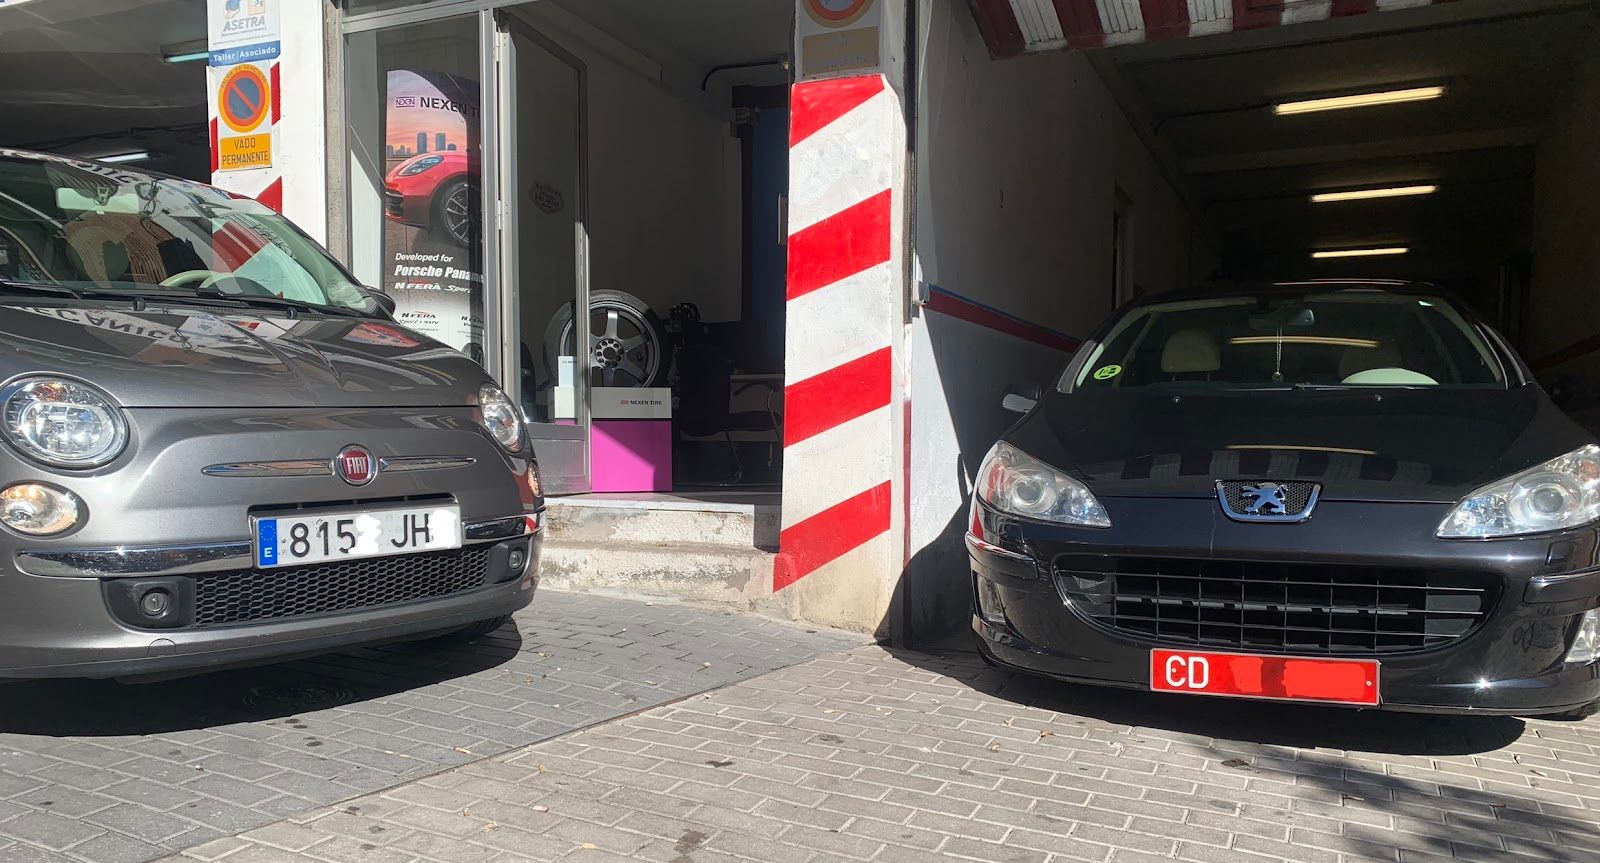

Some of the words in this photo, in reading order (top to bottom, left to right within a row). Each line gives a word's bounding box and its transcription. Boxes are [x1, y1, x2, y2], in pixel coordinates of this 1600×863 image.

[223, 15, 266, 31] ASETRA
[213, 53, 236, 62] Taller
[239, 46, 276, 58] Asociado
[420, 96, 467, 115] NEXEN
[233, 137, 256, 149] VADO
[222, 150, 269, 166] PERMANENTE
[395, 253, 440, 262] Developed
[440, 254, 454, 262] for
[394, 264, 443, 277] Porsche
[346, 456, 368, 475] FIAT
[289, 518, 357, 558] 815
[391, 513, 431, 547] JH
[264, 547, 273, 558] E
[1165, 655, 1210, 689] CD
